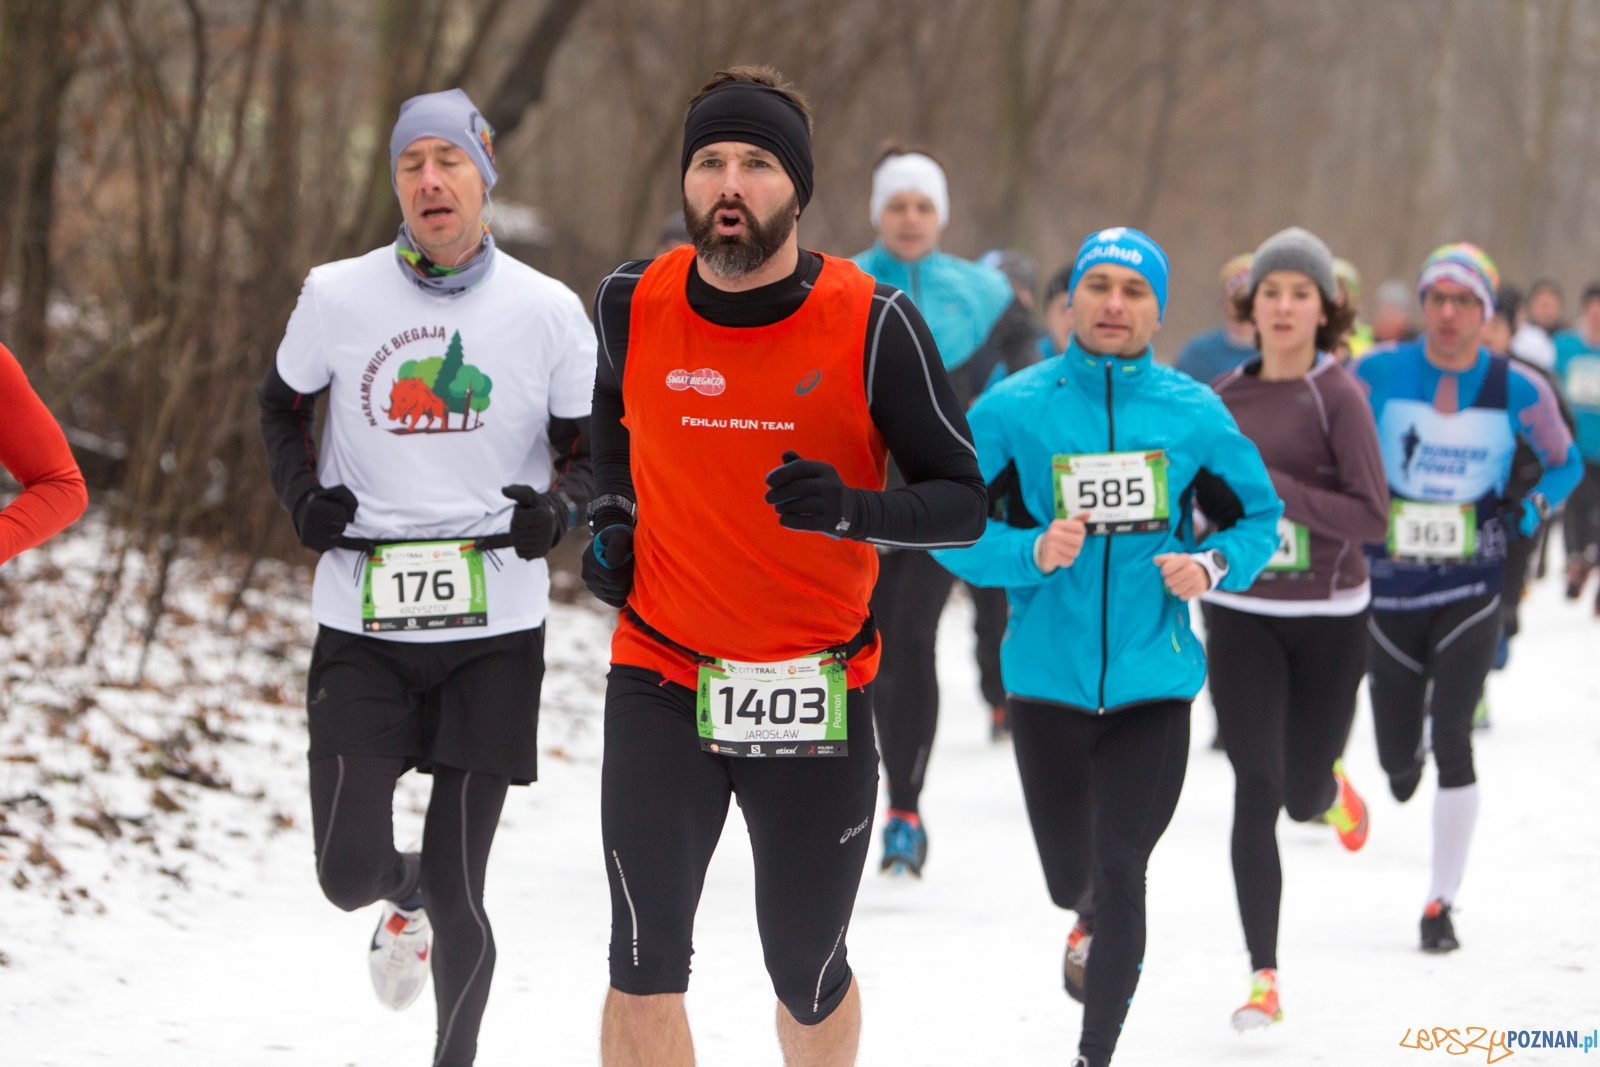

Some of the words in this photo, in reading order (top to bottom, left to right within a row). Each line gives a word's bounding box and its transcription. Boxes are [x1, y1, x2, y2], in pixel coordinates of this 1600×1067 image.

[360, 343, 393, 427] NARAMOWICE
[390, 325, 447, 350] BIEGAJĄ
[667, 373, 690, 385] ŚWIAT
[689, 375, 724, 386] BIEGACZA
[729, 418, 759, 430] RUN
[1077, 477, 1145, 509] 585
[1406, 520, 1456, 547] 363
[391, 569, 455, 603] 176
[399, 604, 449, 615] KRZYSZTOF
[718, 686, 826, 725] 1403
[833, 694, 841, 729] Poznań
[743, 729, 800, 740] JAROSŁAW
